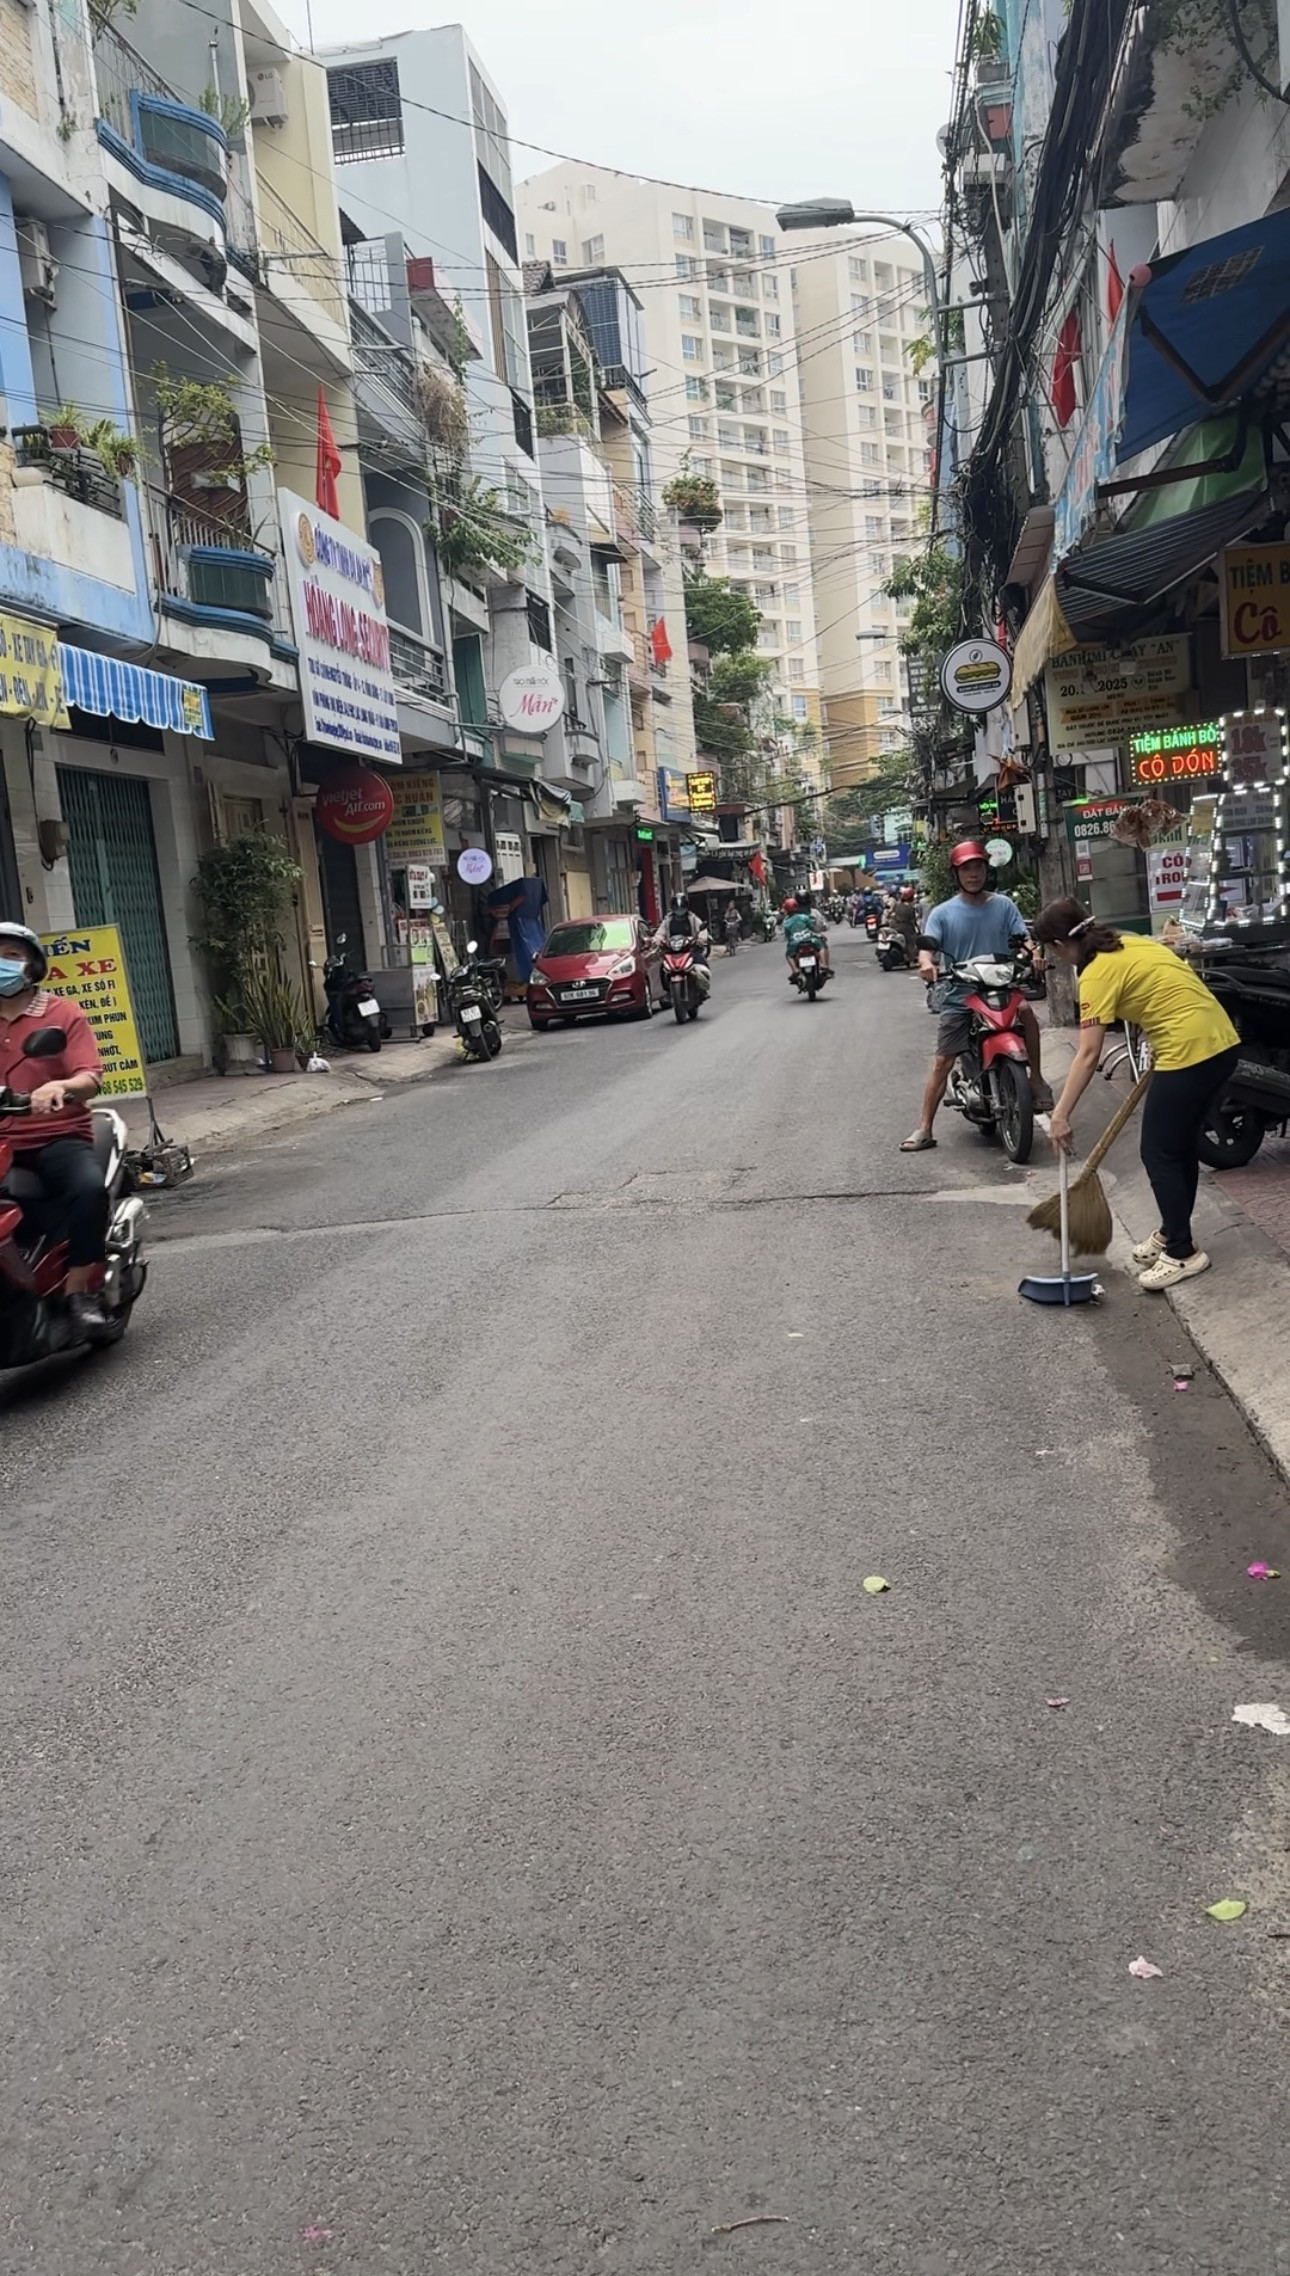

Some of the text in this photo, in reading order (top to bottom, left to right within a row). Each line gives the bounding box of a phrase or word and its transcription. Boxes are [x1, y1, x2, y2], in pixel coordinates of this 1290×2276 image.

[1229, 558, 1273, 595] TIỆM
[1234, 602, 1282, 644] Cô
[1134, 734, 1160, 754] TIỆM
[1164, 730, 1196, 749] BÁNH
[1139, 754, 1164, 779] CÔ
[46, 959, 117, 981] A XE
[53, 987, 65, 996] XE
[66, 985, 80, 995] GA,
[81, 982, 93, 993] XE
[94, 978, 106, 991] SỐ
[107, 980, 116, 990] FI
[104, 1011, 127, 1023] PHUN
[113, 1079, 128, 1094] 545
[128, 1077, 143, 1092] 529
